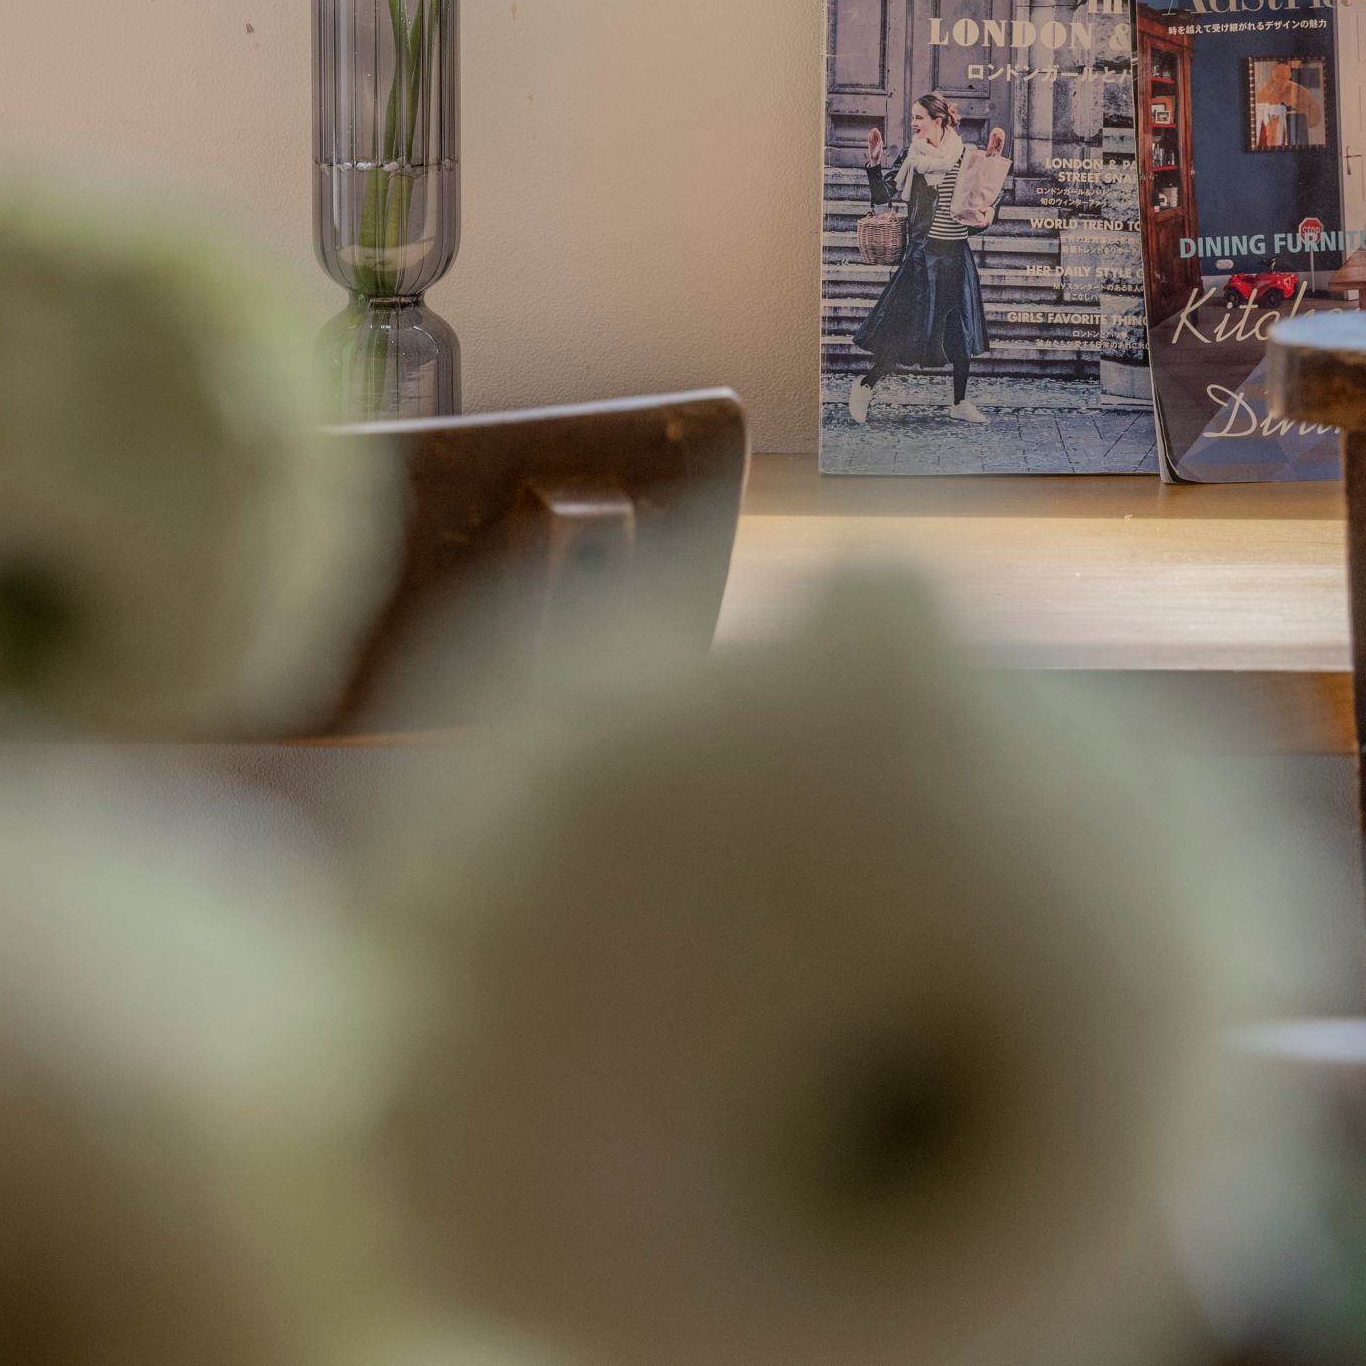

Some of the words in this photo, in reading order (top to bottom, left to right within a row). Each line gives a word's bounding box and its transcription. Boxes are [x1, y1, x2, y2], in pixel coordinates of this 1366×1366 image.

[928, 17, 1093, 50] LONDON
[1109, 23, 1131, 51] &
[1045, 157, 1103, 169] LONDON
[1109, 159, 1116, 170] &
[1058, 171, 1100, 183] STREET
[1030, 217, 1078, 230] WORLD
[1082, 219, 1124, 231] TREND
[1179, 234, 1265, 258] DINING
[1026, 265, 1051, 276] HER
[1055, 266, 1092, 277] DAILY
[1095, 267, 1132, 279] STYLE
[1007, 312, 1044, 323] GIRLS
[1047, 313, 1108, 325] FAVORITE
